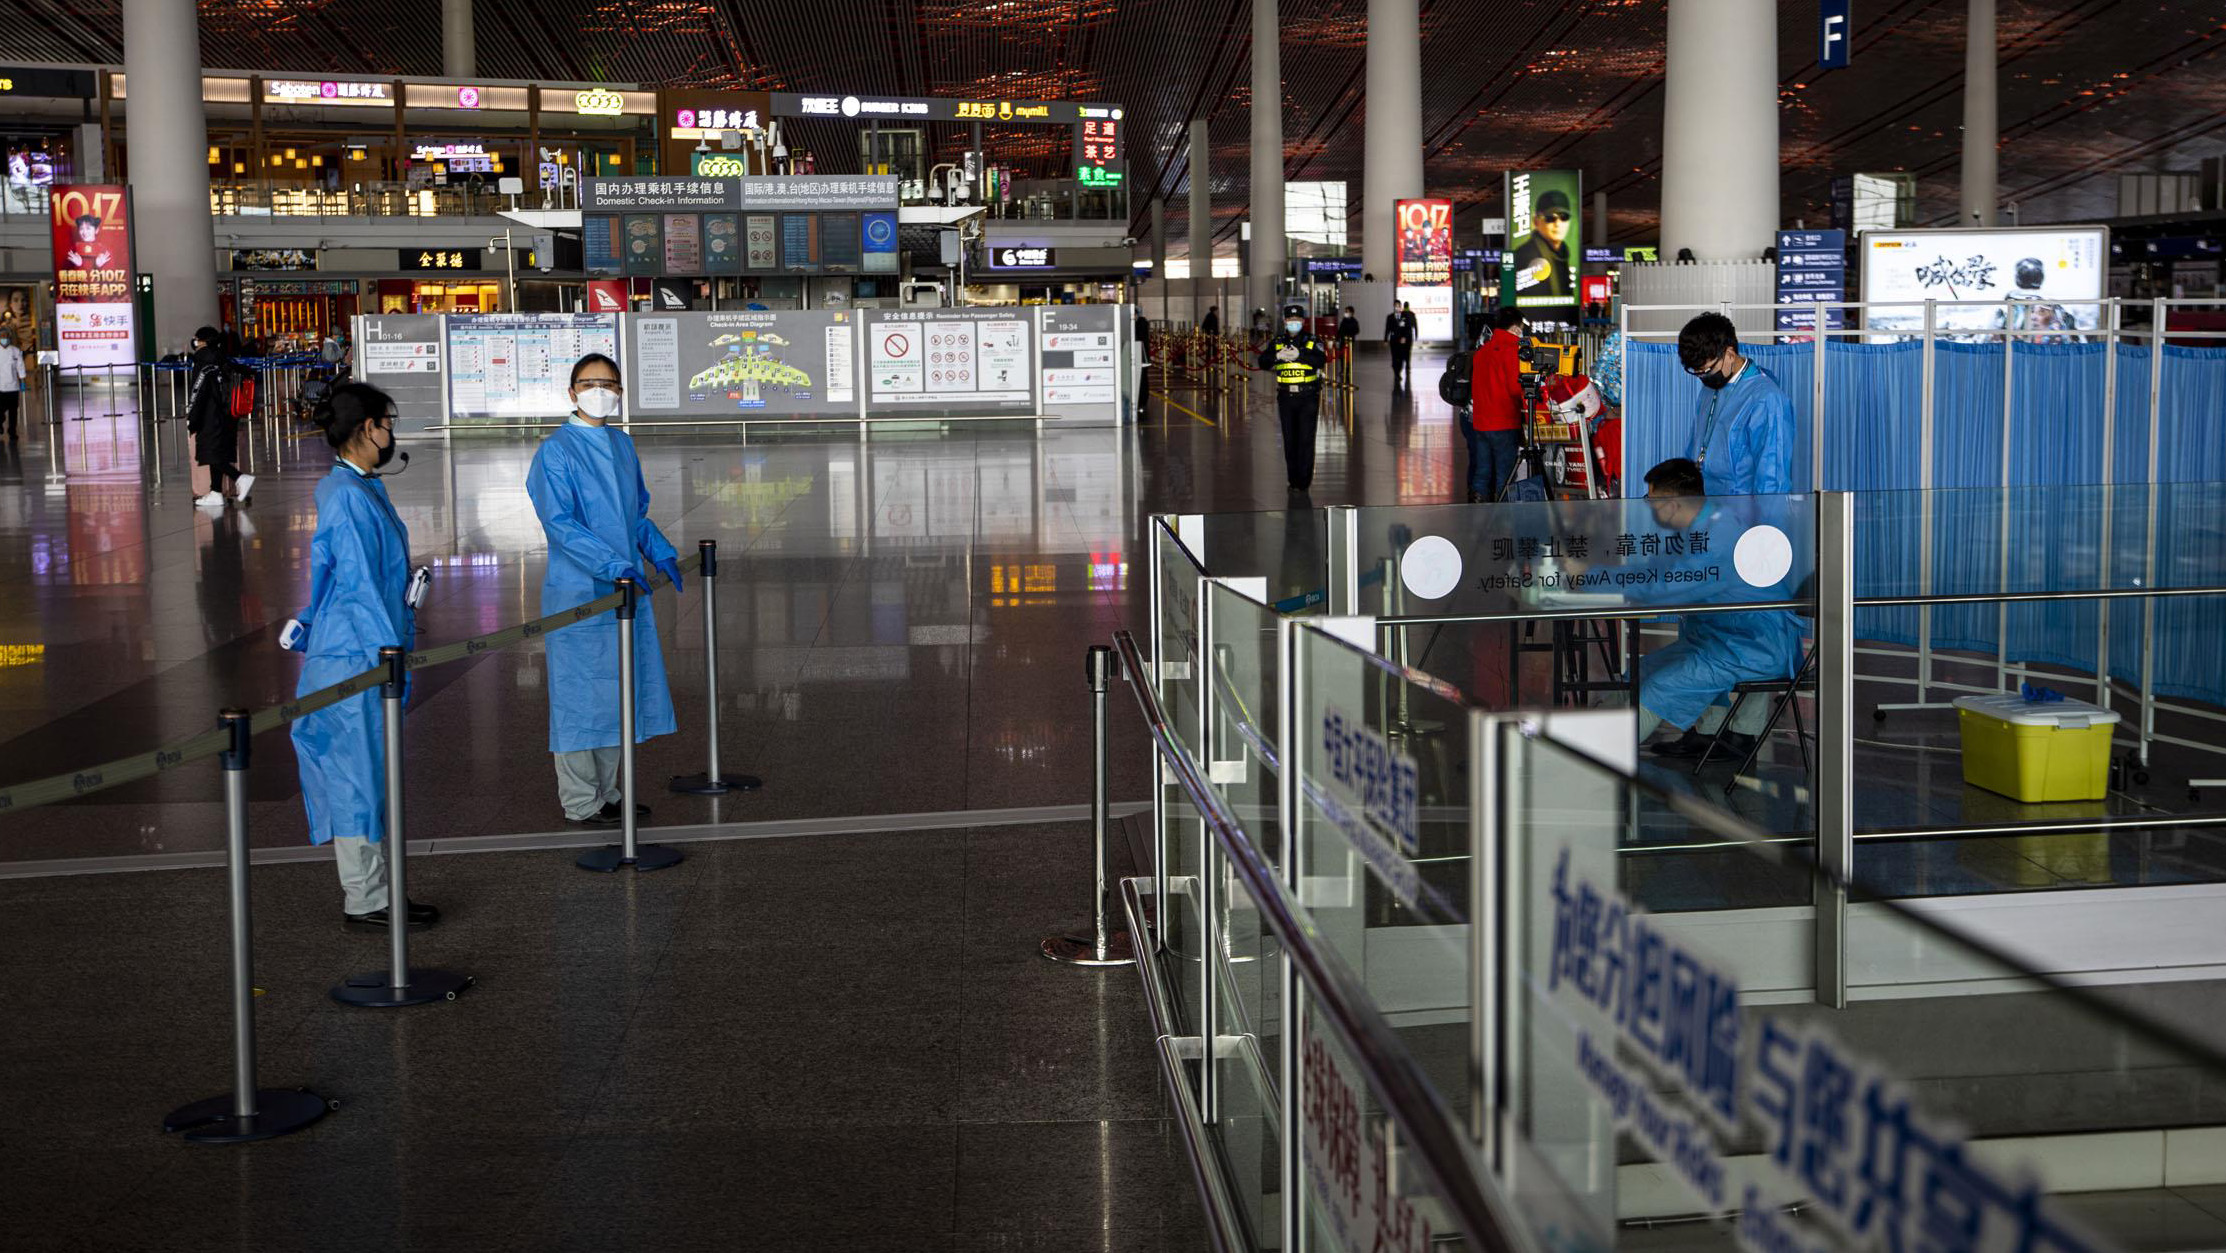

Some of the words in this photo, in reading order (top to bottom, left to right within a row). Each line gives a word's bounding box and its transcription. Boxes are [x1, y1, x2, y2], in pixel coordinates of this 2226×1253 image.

[1824, 15, 1843, 60] F
[1016, 106, 1048, 118] mymill
[1085, 122, 1115, 135] 足道
[1085, 145, 1115, 158] 茶艺
[1079, 167, 1105, 180] 素食
[595, 182, 725, 195] 国内办理乘机手续信息
[596, 197, 635, 205] Domestic
[638, 197, 675, 205] Check-in
[419, 252, 463, 267] 全聚德
[103, 315, 129, 326] 快手
[883, 312, 934, 320] 安全信息提示
[1042, 311, 1056, 331] F
[366, 320, 382, 341] H
[1059, 323, 1078, 331] 19-34
[1531, 321, 1556, 334] 抖音
[382, 333, 403, 341] 01-16
